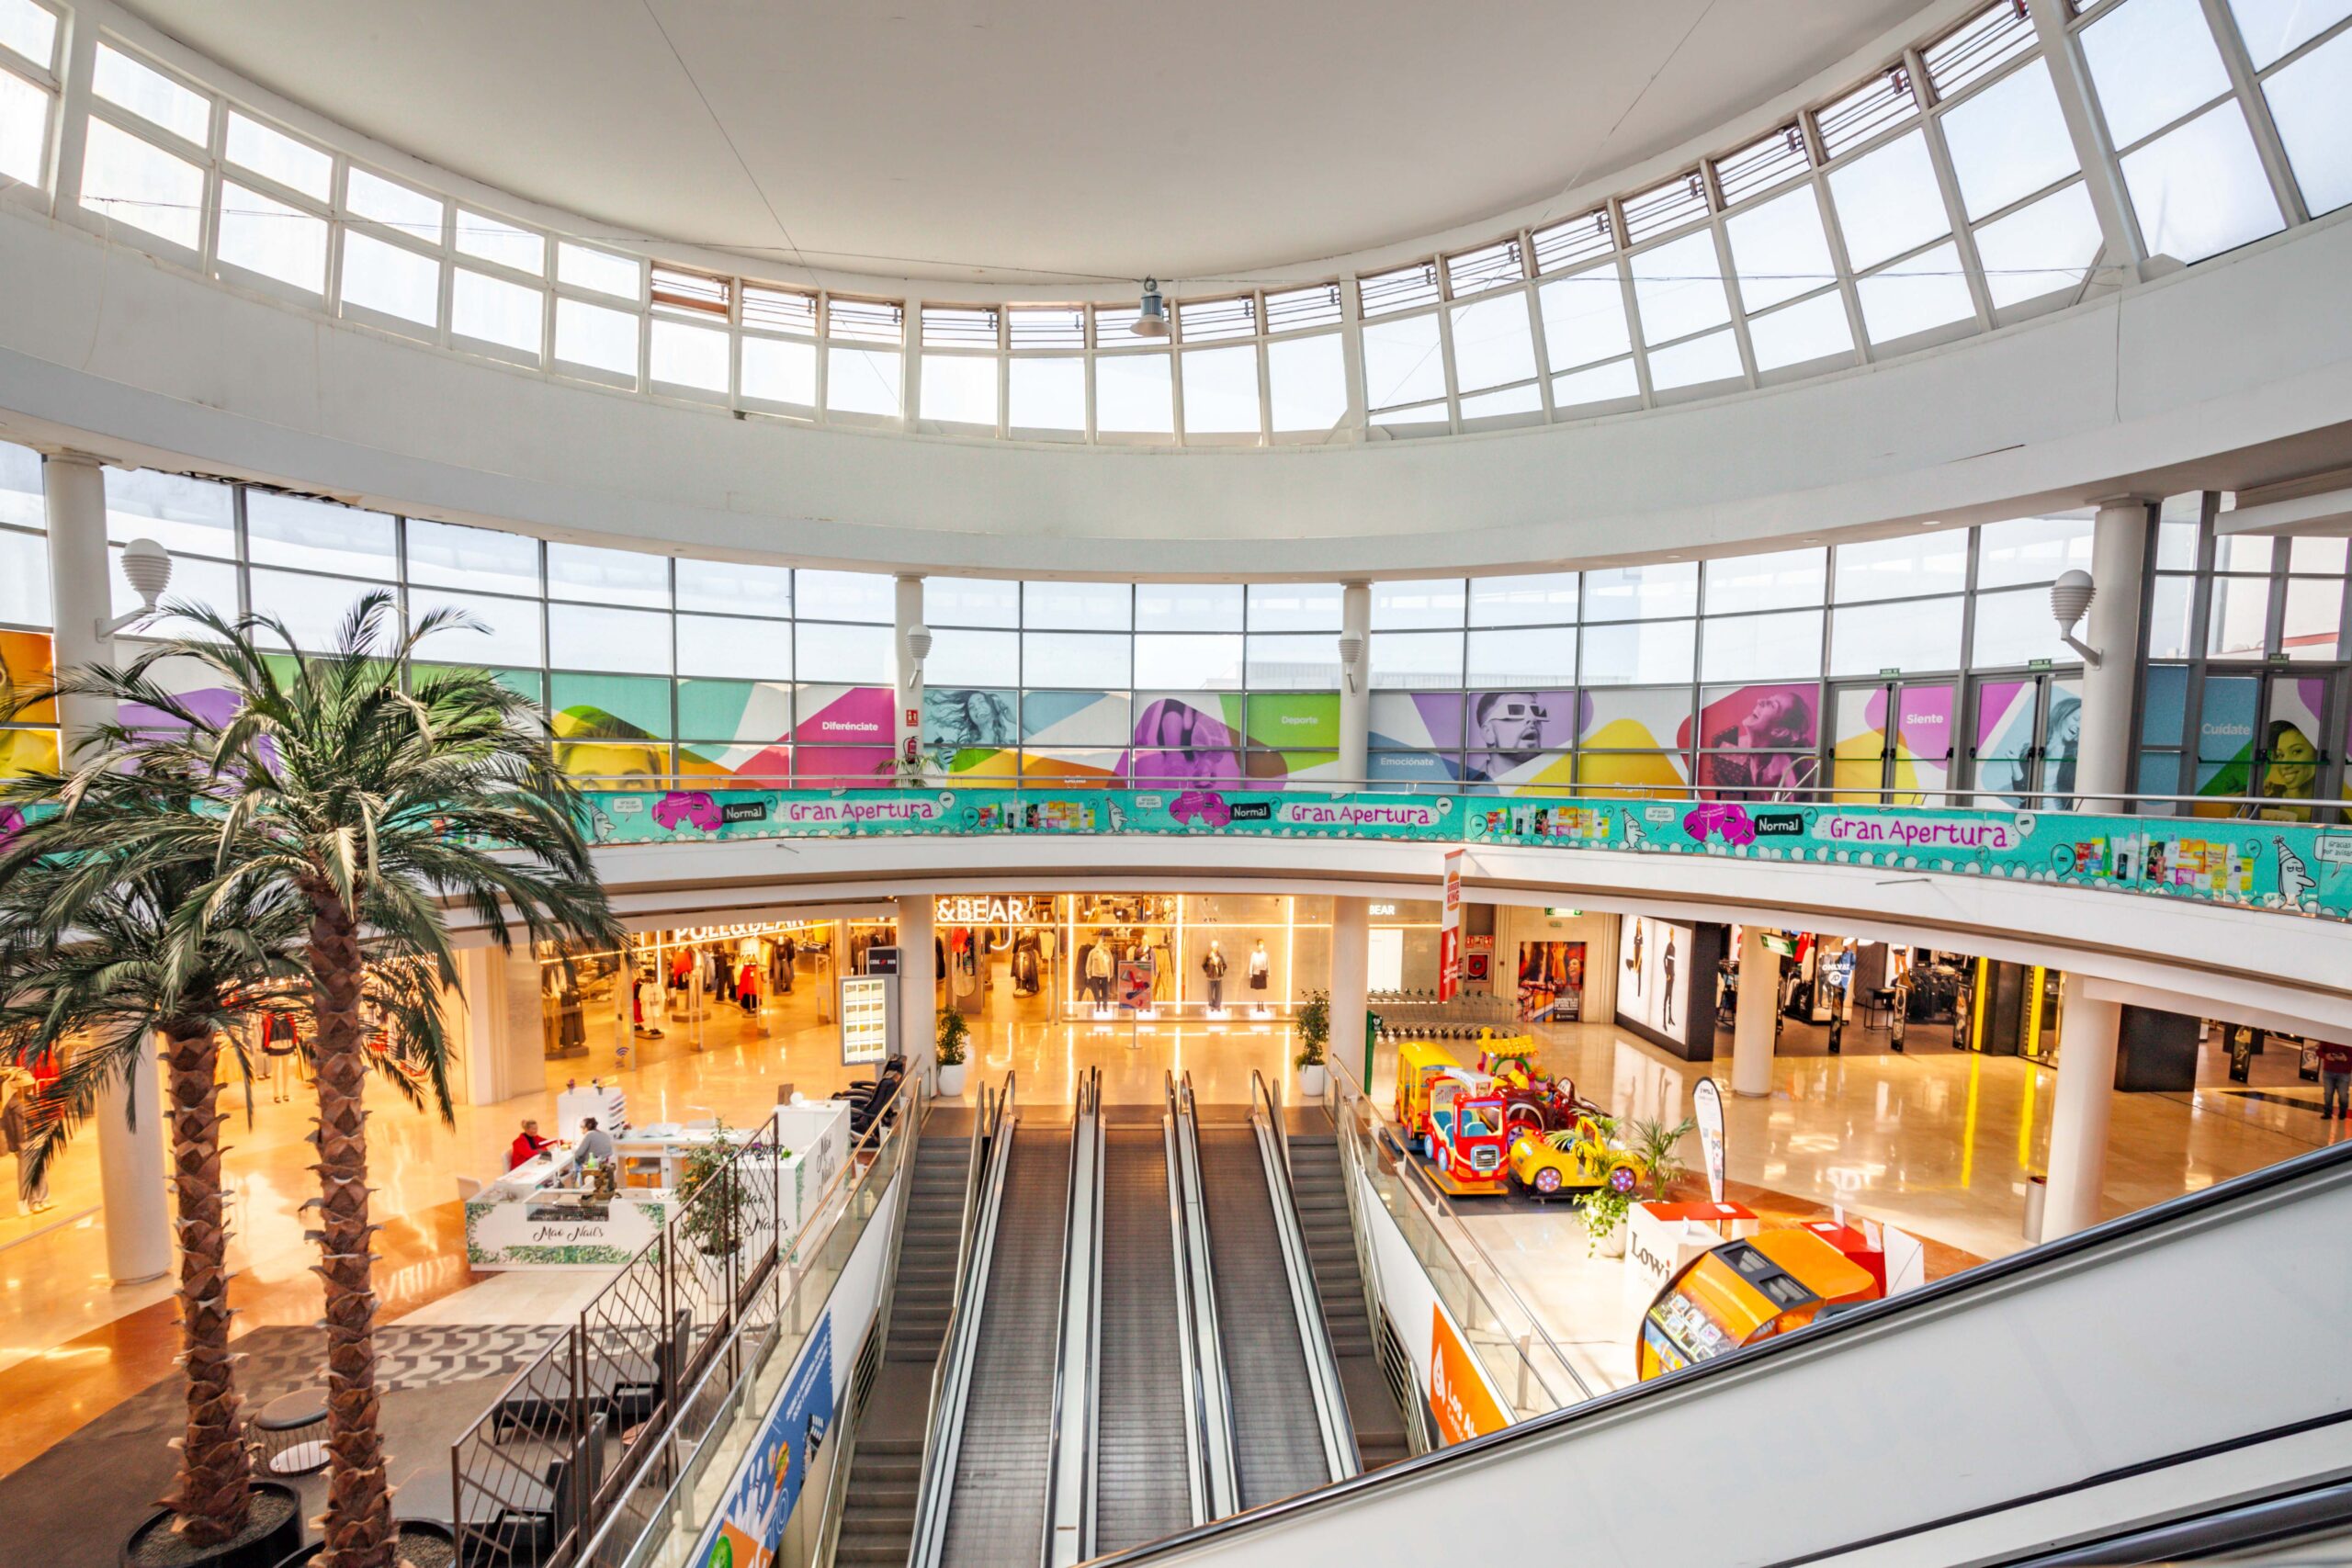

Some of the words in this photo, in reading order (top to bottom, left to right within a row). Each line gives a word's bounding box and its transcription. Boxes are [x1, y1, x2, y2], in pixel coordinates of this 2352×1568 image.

[821, 718, 879, 732] Diferénciate
[1281, 715, 1318, 727] Deporte
[1905, 712, 1944, 725] Siente
[2201, 722, 2251, 736] Cuídate
[1380, 755, 1435, 768] Emociónate
[726, 805, 763, 820] Normal
[790, 799, 837, 821] Gran
[842, 797, 934, 823] Apertura
[1233, 806, 1268, 818] Normal
[1291, 803, 1336, 824] Gran
[1340, 802, 1430, 827] Apertura
[1758, 818, 1800, 832] Normal
[1829, 817, 1883, 840] Gran
[1888, 819, 2008, 848] Apertura
[1447, 890, 1460, 905] KING
[1369, 904, 1396, 916] BEAR
[533, 1225, 564, 1242] Mao
[1631, 1230, 1671, 1282] Lowi
